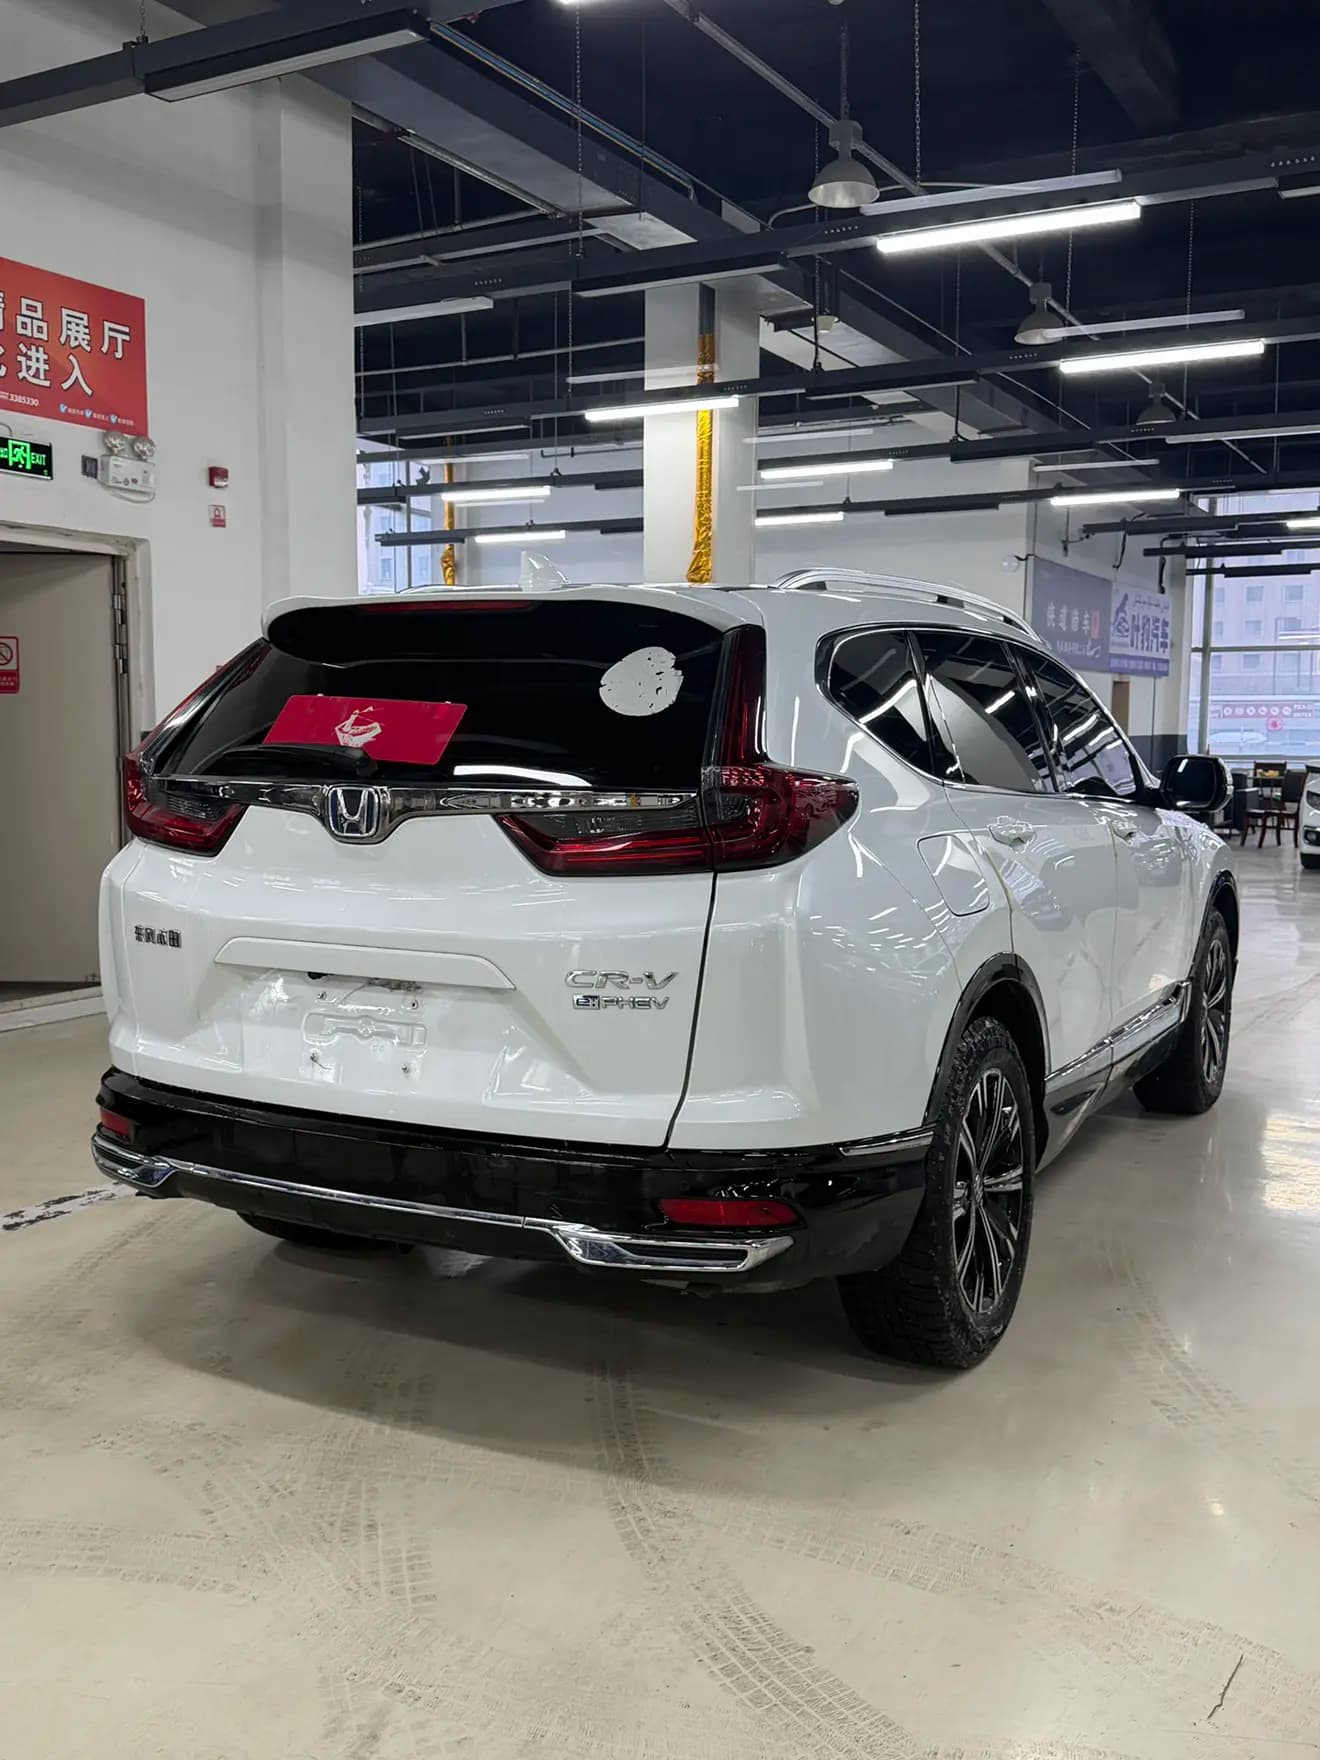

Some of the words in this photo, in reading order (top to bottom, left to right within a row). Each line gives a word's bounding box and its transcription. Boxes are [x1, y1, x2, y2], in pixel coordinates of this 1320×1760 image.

[0, 291, 130, 359] 品展厅
[0, 343, 93, 396] 进入
[31, 452, 46, 466] EXIT
[564, 969, 679, 990] CR-V
